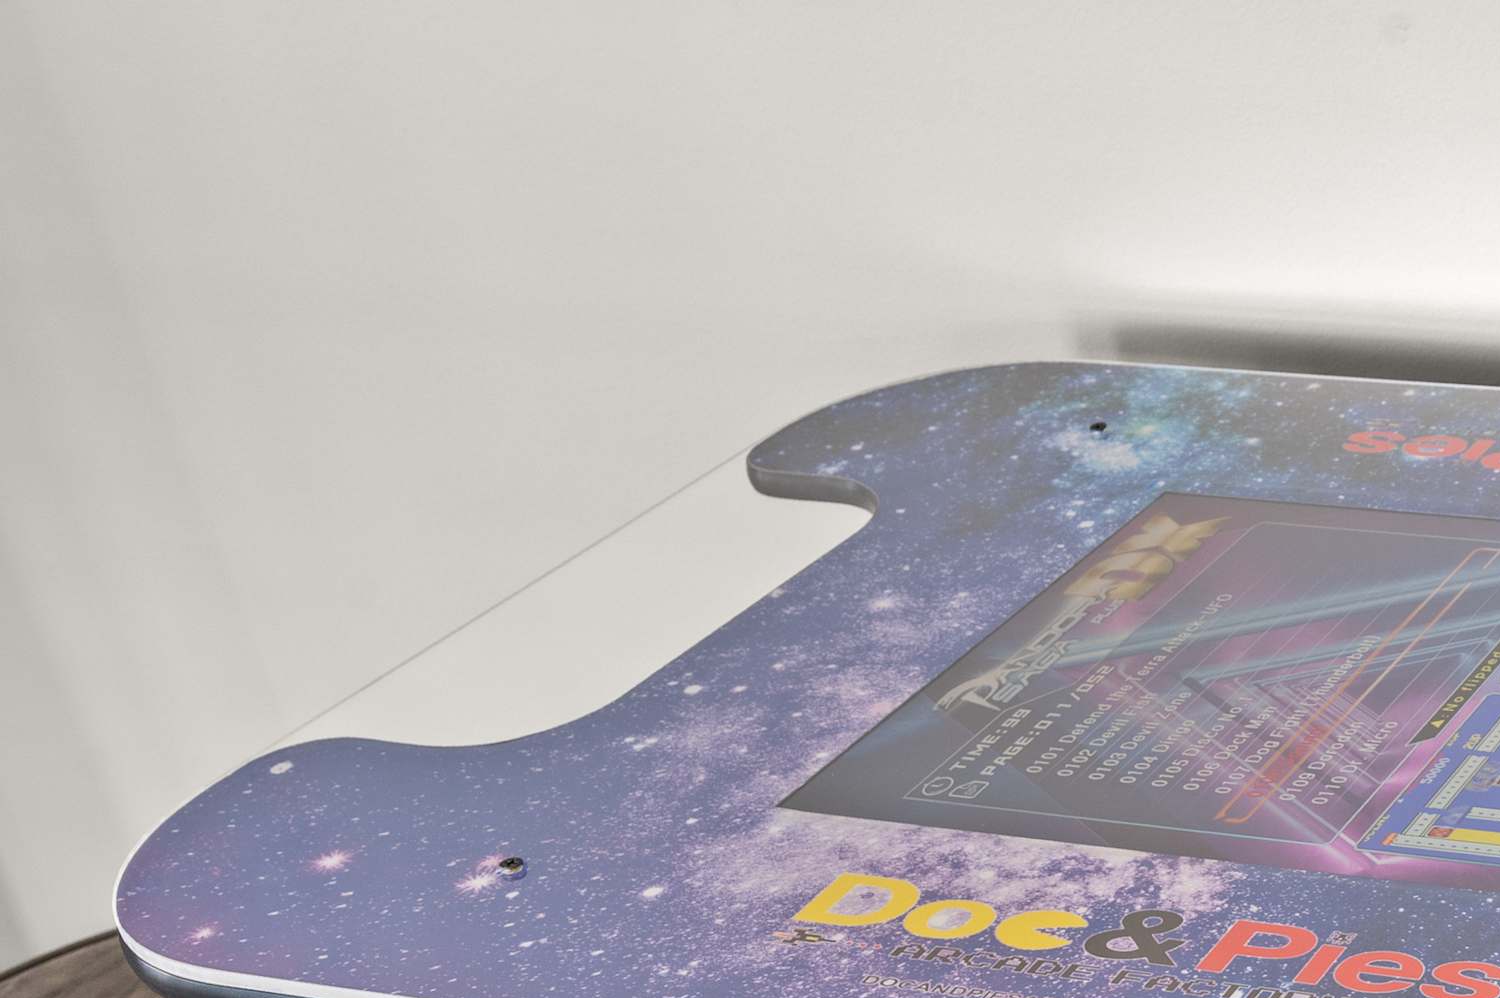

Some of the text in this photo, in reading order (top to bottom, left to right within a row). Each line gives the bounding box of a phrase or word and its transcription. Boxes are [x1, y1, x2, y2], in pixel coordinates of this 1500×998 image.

[944, 707, 1035, 773] TIME:99
[1021, 745, 1068, 774] 0101
[1055, 702, 1116, 743] Defend
[1102, 684, 1136, 701] the
[1122, 654, 1169, 683] Terra
[1052, 748, 1100, 777] 0102
[1086, 718, 1133, 747] Devil
[1084, 690, 1196, 781] 0103 Devil Zone
[1116, 718, 1201, 784] 0104 Dingo
[1179, 760, 1225, 791] 0106
[1210, 729, 1256, 760] Dock
[1242, 705, 1280, 728] Man
[1212, 766, 1255, 794] 0107
[1243, 739, 1283, 763] Dog
[1268, 708, 1313, 738] Fight
[1148, 758, 1193, 788] 0105
[1180, 722, 1229, 756] Disco
[1276, 771, 1319, 801] 0109
[1308, 775, 1351, 805] 0110
[1357, 720, 1401, 752] Micro
[793, 872, 1088, 951] Doc
[1082, 908, 1186, 967] &
[889, 943, 1096, 982] ARCADE
